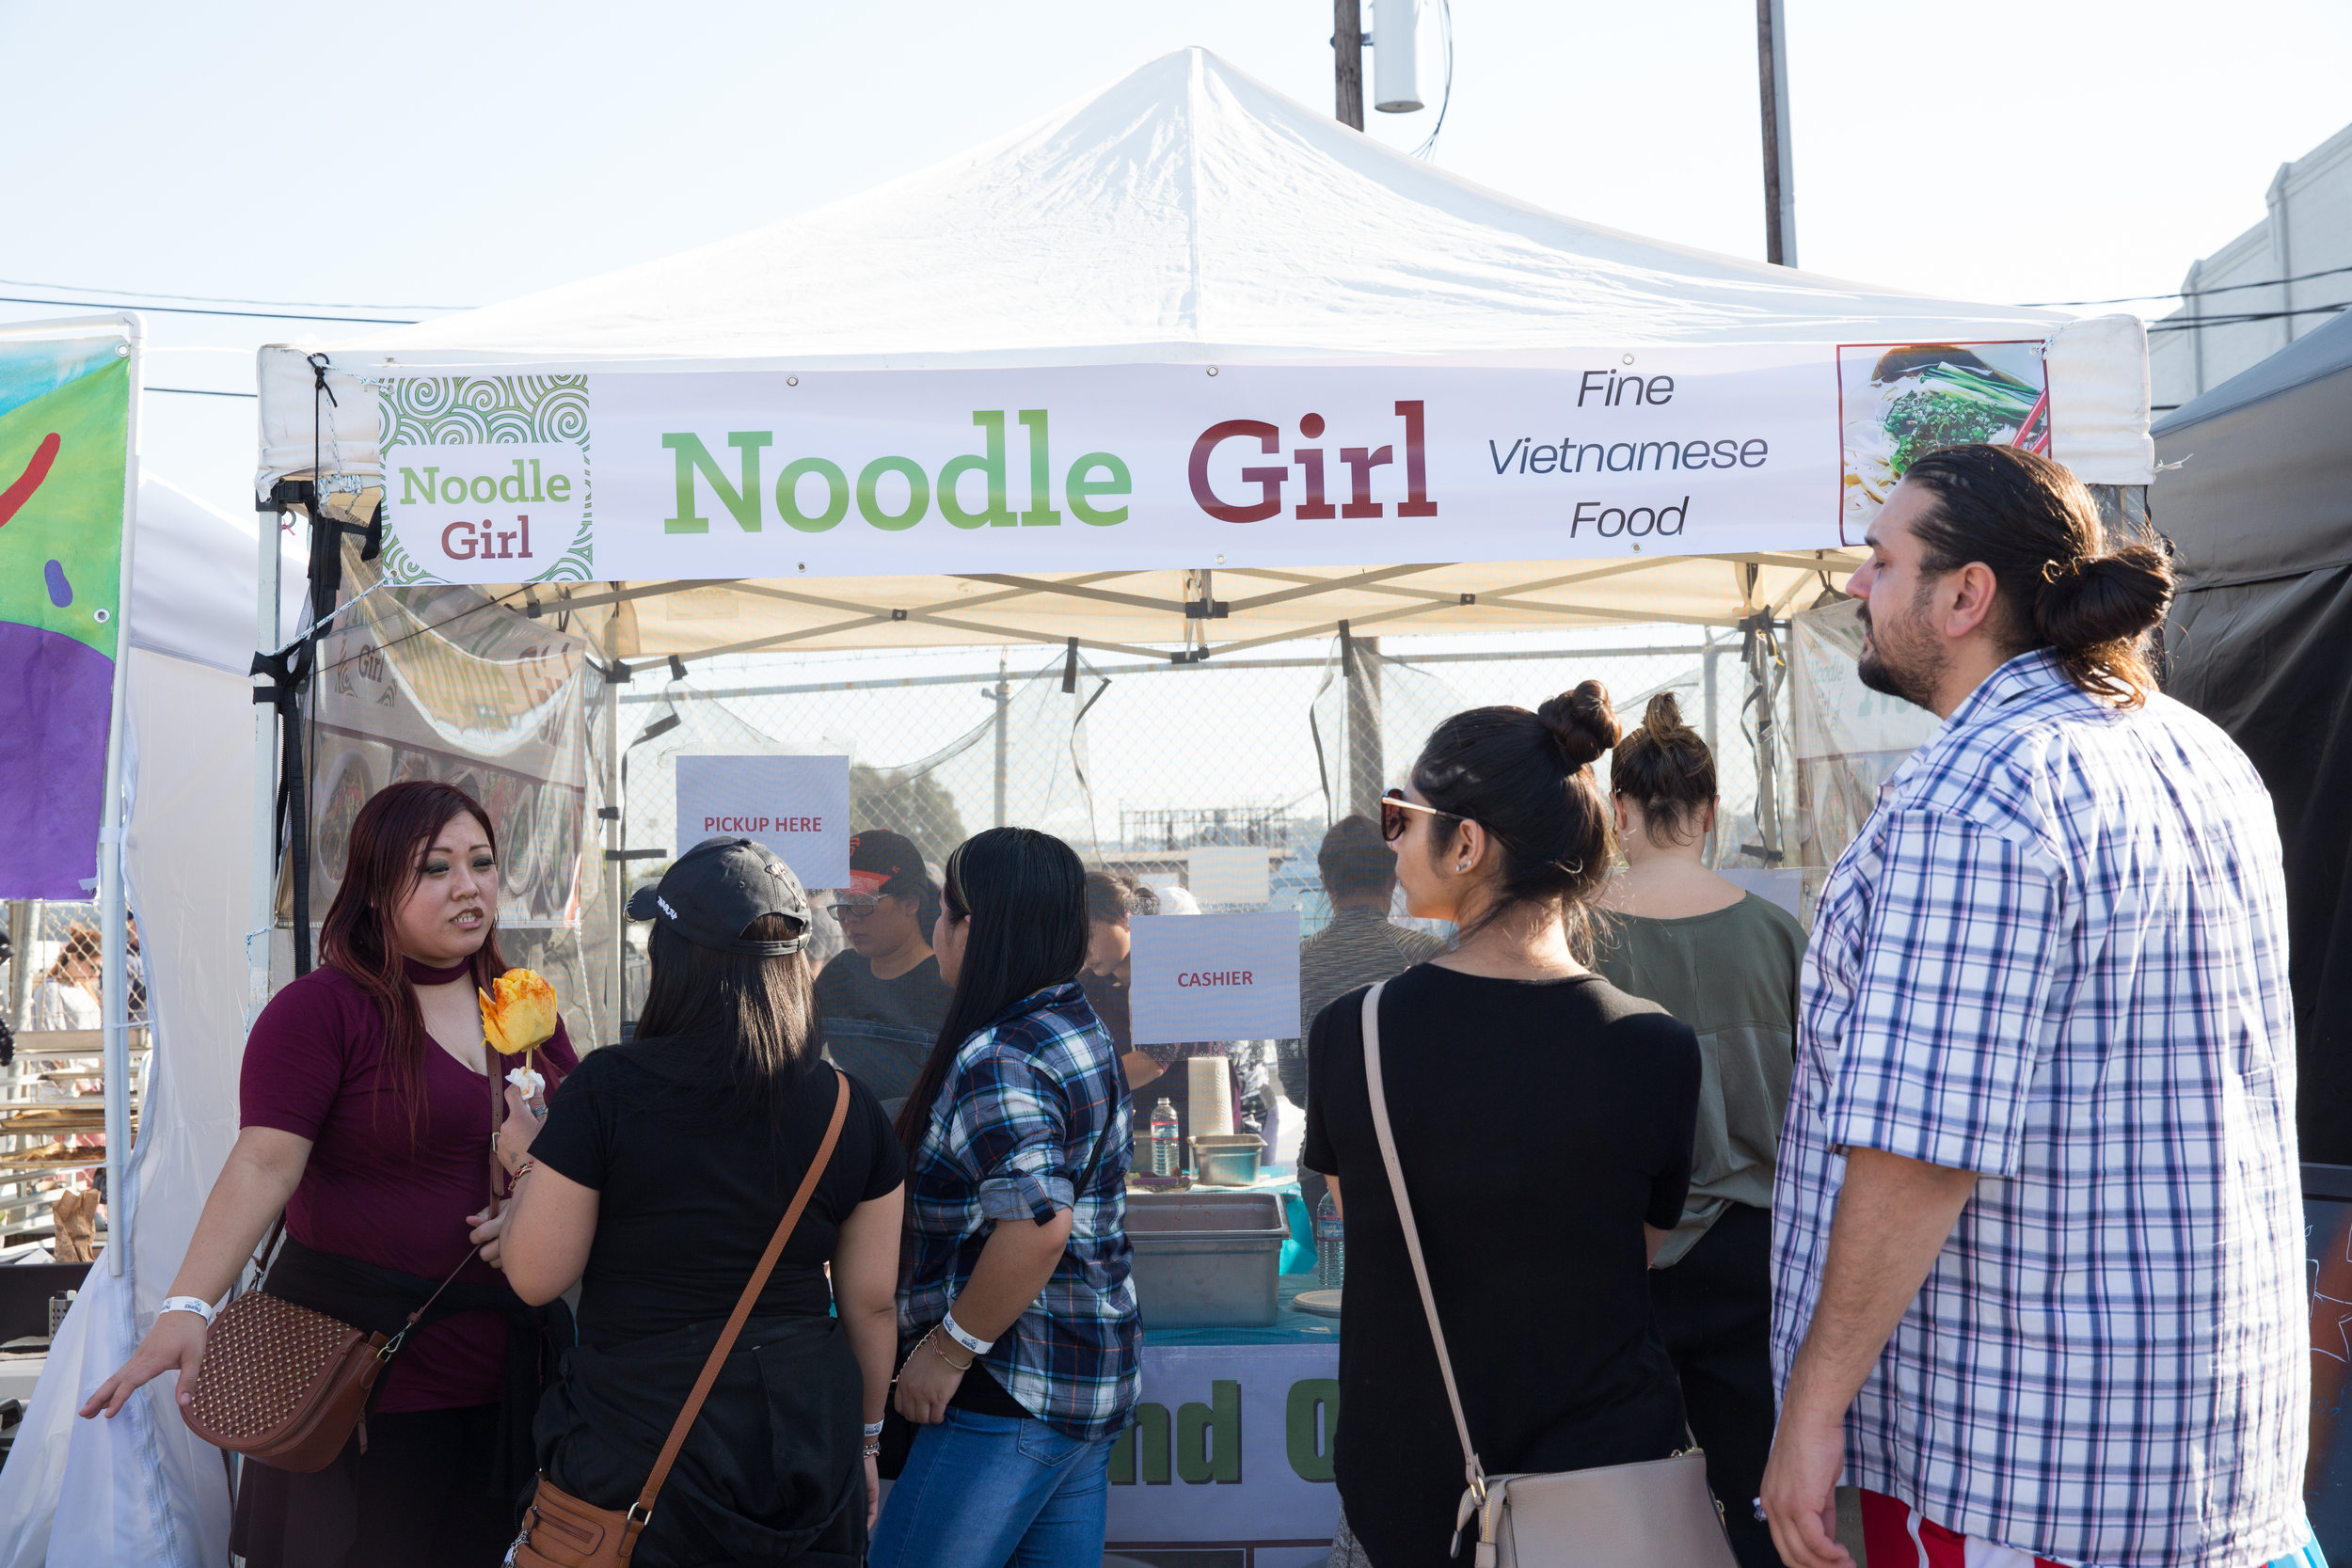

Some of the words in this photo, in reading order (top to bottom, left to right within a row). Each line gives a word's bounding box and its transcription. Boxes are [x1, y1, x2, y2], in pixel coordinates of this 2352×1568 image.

[1577, 369, 1676, 408] Fine
[662, 409, 1134, 536] Noodle
[1188, 400, 1439, 525] Girl
[1488, 436, 1770, 477] Vietnamese
[399, 458, 572, 506] Noodle
[439, 515, 534, 561] Girl
[1569, 496, 1691, 540] Food
[704, 816, 771, 833] PICKUP
[775, 816, 823, 833] HERE
[1177, 971, 1254, 989] CASHIER
[1107, 1379, 1243, 1486] nd
